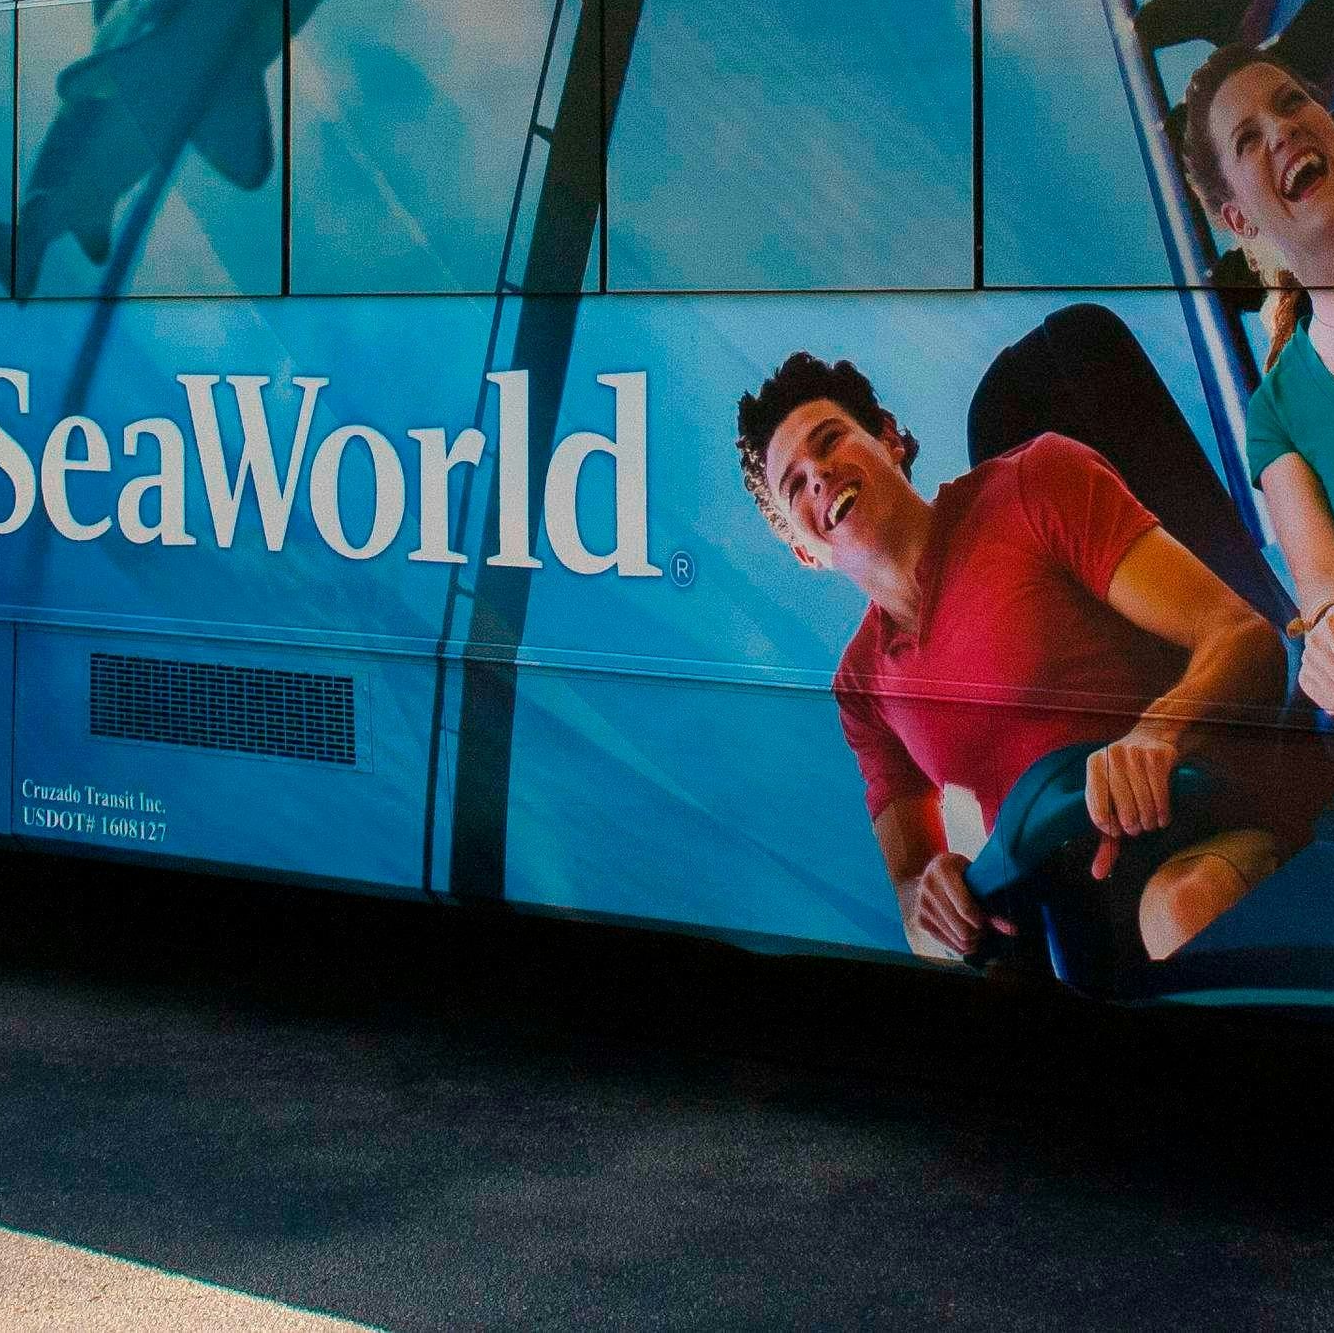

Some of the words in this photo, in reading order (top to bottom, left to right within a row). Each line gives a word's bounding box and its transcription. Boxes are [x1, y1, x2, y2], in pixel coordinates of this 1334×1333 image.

[22, 778, 81, 804] Cruzado
[84, 785, 135, 810] Transit
[140, 791, 167, 814] Inc.
[23, 805, 96, 834] USDOT#
[101, 815, 168, 843] 1608127
